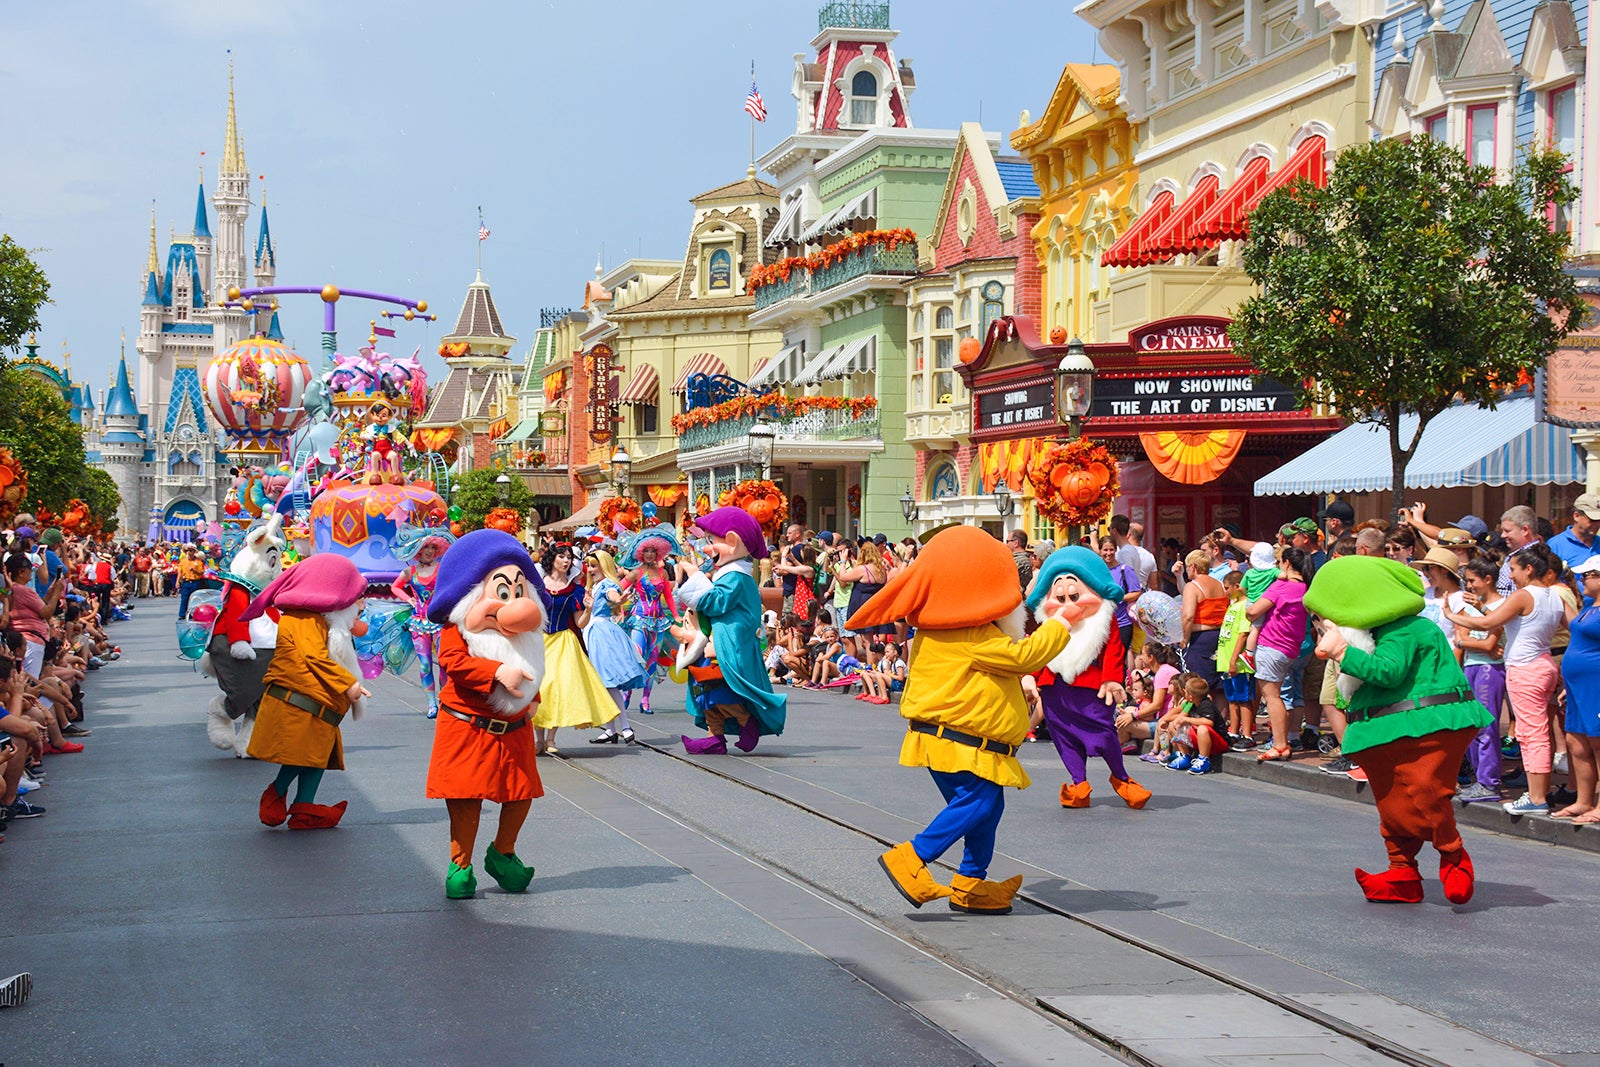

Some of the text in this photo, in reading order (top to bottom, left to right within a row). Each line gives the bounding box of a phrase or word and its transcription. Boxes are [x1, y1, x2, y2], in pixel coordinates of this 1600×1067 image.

[1167, 325, 1201, 337] MAIN
[596, 357, 606, 400] CRYSTAL
[1134, 378, 1253, 394] NOW SHOWING
[1110, 397, 1277, 415] THE ART OF DISNEY
[596, 405, 606, 430] ARTS
[991, 412, 1001, 425] THE
[1003, 411, 1013, 424] ART
[1015, 409, 1023, 422] OF
